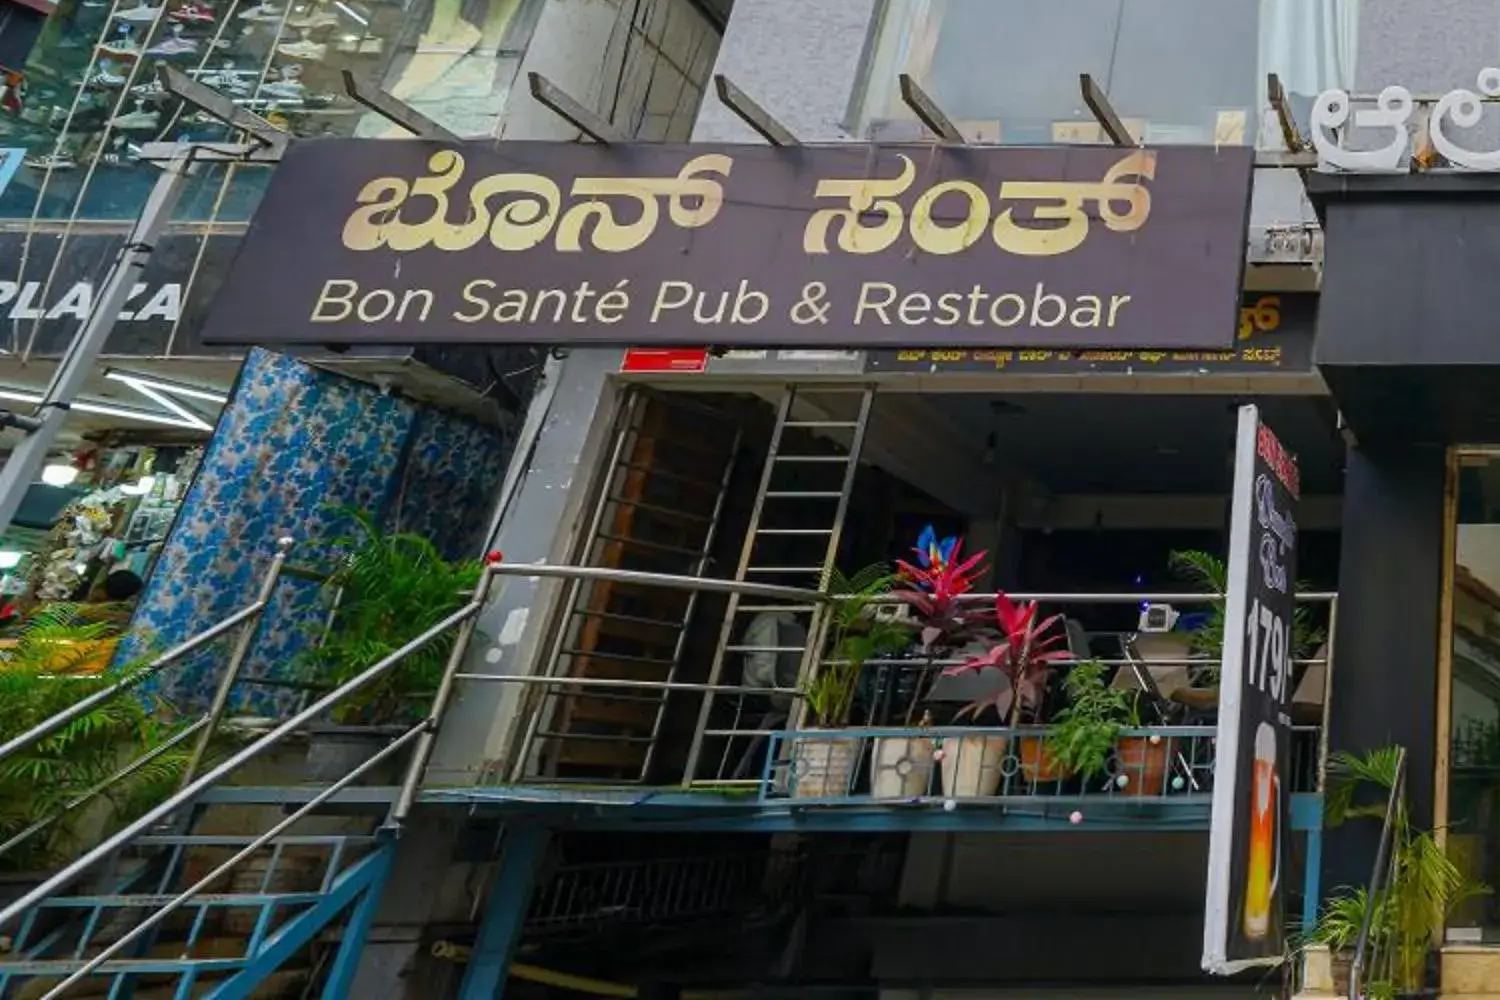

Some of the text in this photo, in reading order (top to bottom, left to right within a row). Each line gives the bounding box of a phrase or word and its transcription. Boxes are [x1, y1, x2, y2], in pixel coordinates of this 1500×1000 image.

[310, 278, 1132, 328] Bon Santé Pub & Restobar
